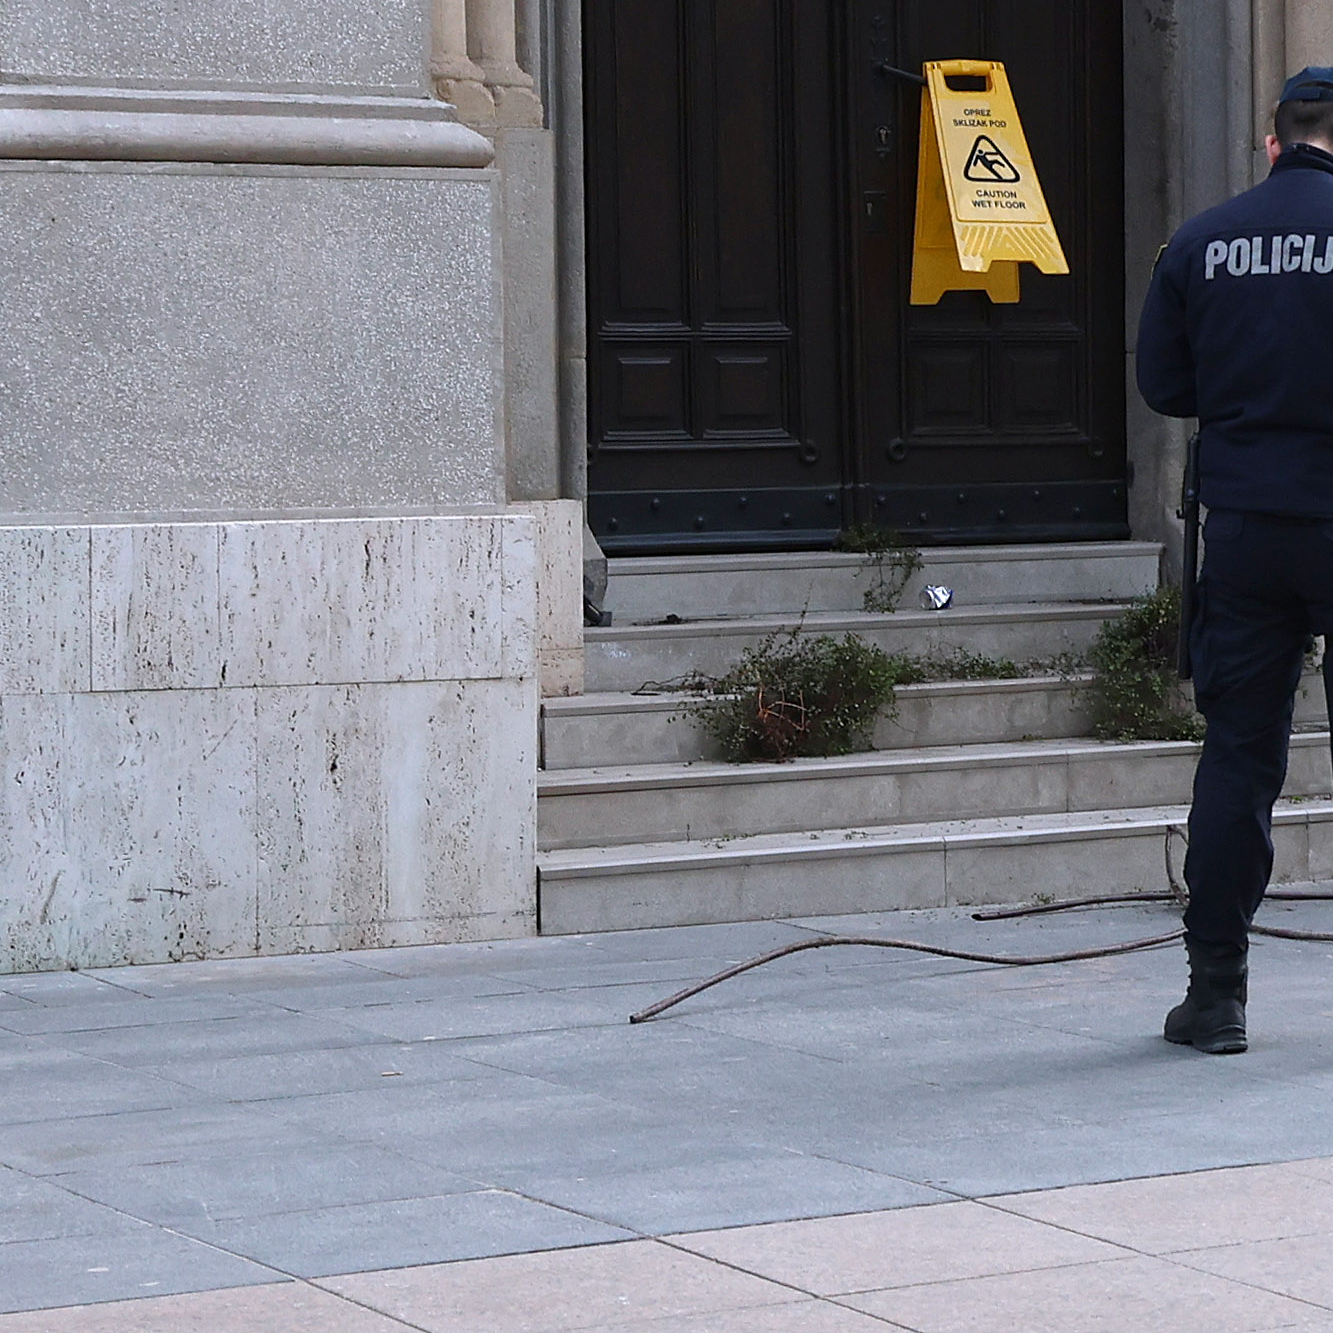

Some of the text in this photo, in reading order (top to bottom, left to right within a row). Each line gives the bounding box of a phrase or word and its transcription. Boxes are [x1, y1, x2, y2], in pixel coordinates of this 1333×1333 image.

[964, 109, 991, 117] OPREZ
[953, 119, 1007, 128] SKLIZAK POD
[977, 190, 1017, 199] CAUTION
[972, 200, 1026, 209] WET FLOOR
